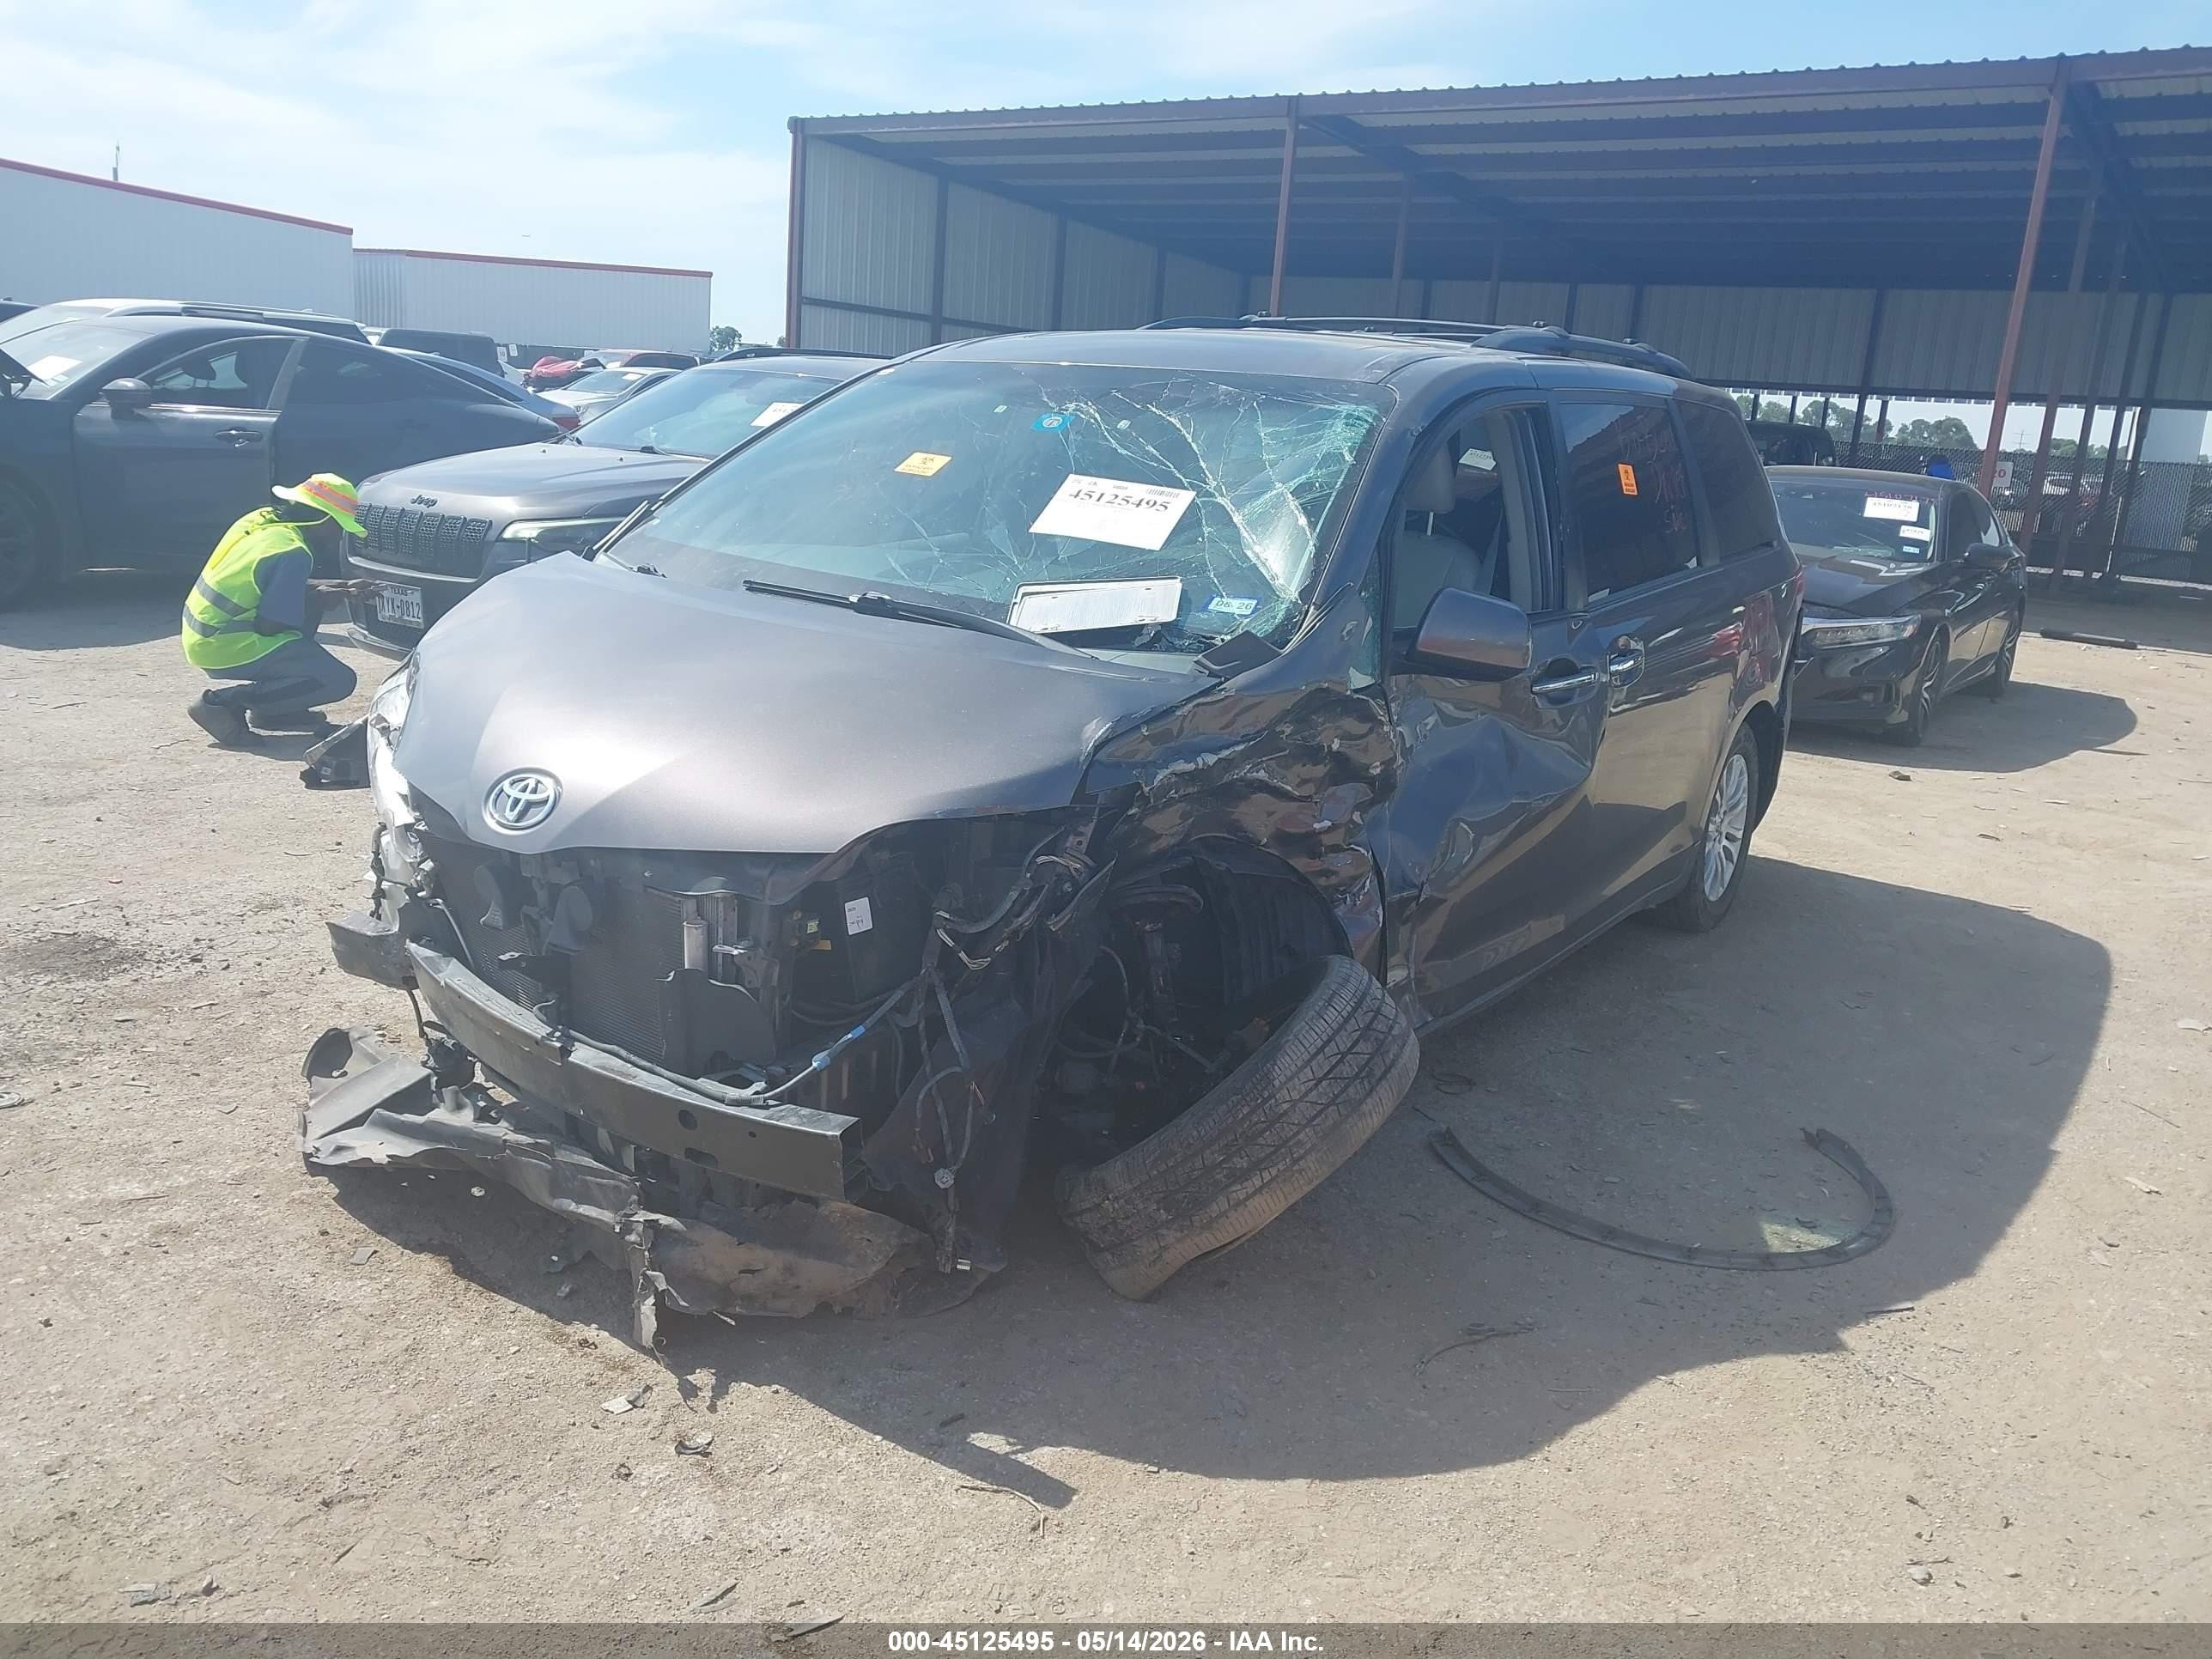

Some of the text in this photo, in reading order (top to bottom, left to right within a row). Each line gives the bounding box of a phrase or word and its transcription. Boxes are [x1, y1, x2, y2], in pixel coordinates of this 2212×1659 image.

[410, 494, 439, 508] Jeep
[1069, 488, 1171, 513] 45125495
[390, 586, 408, 597] TEXAS
